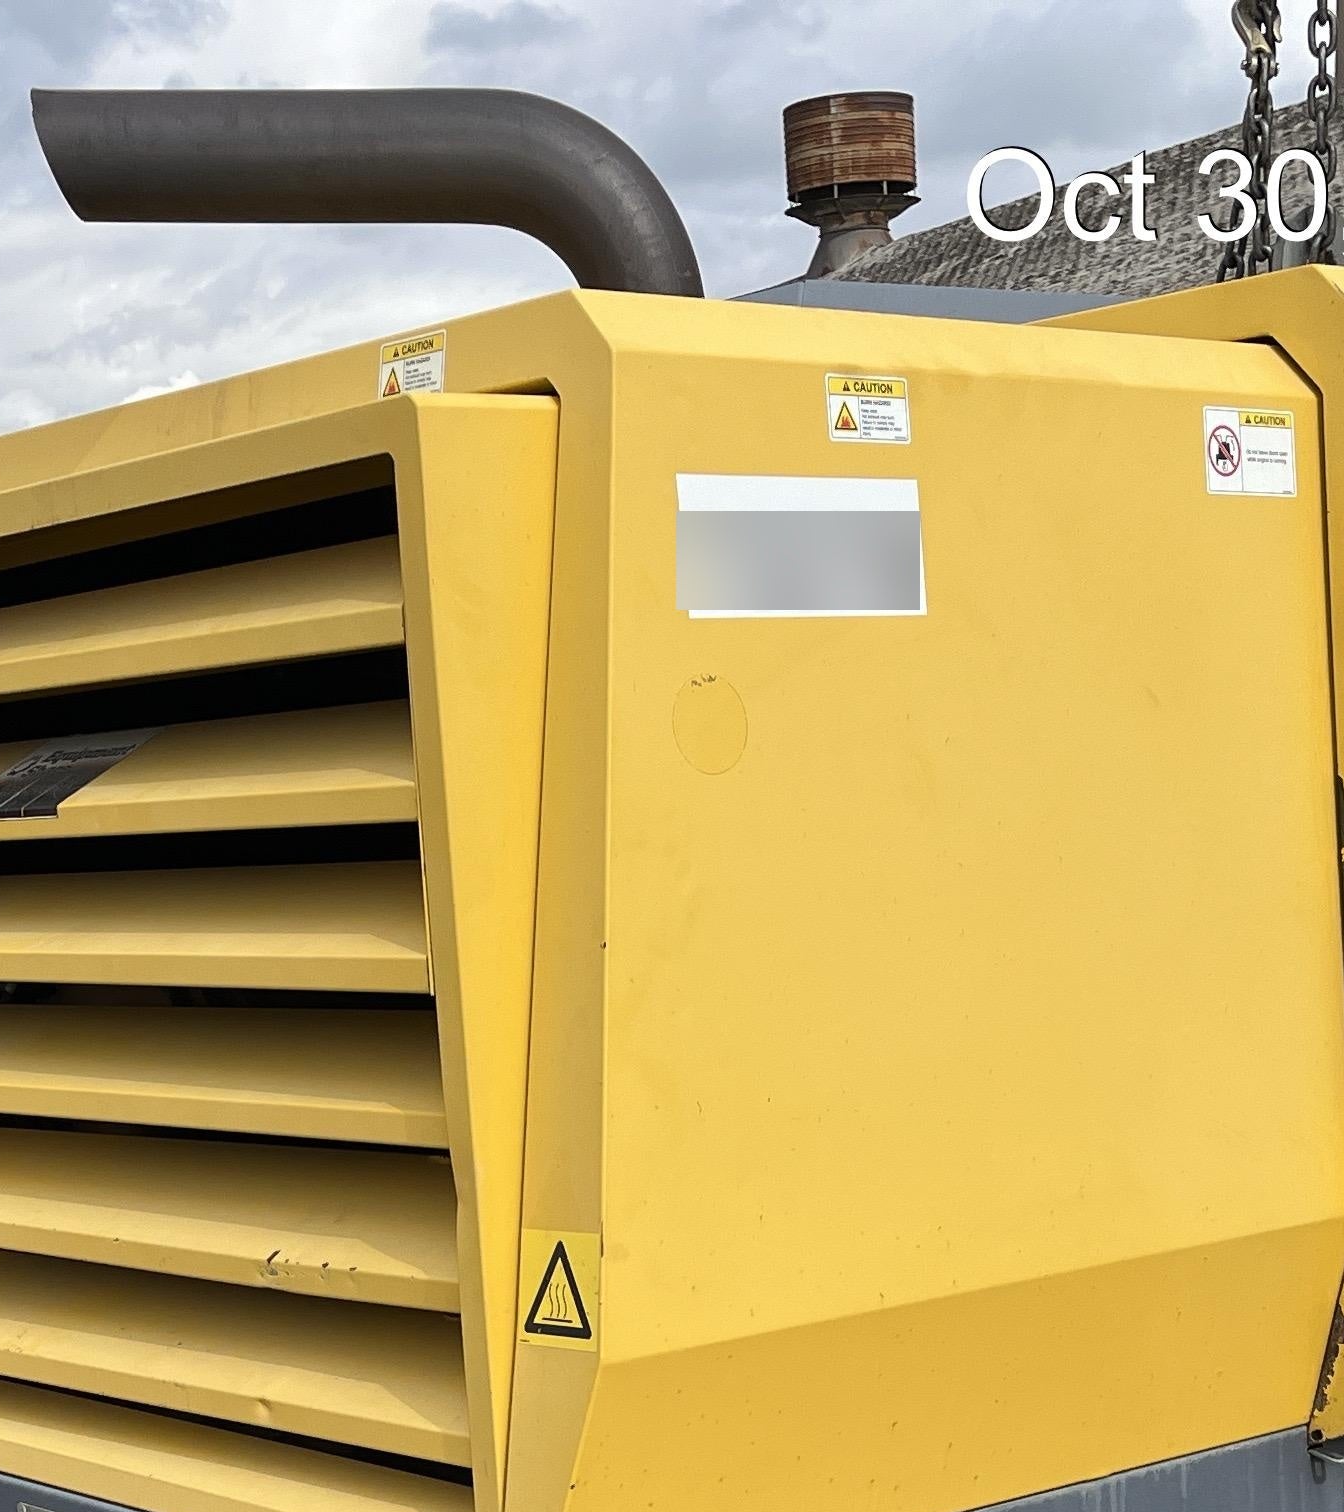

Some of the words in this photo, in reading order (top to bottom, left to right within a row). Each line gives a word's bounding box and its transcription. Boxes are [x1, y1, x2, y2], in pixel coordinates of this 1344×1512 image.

[401, 339, 434, 355] CAUTION
[853, 381, 893, 394] CAUTION
[1253, 415, 1286, 426] CAUTION
